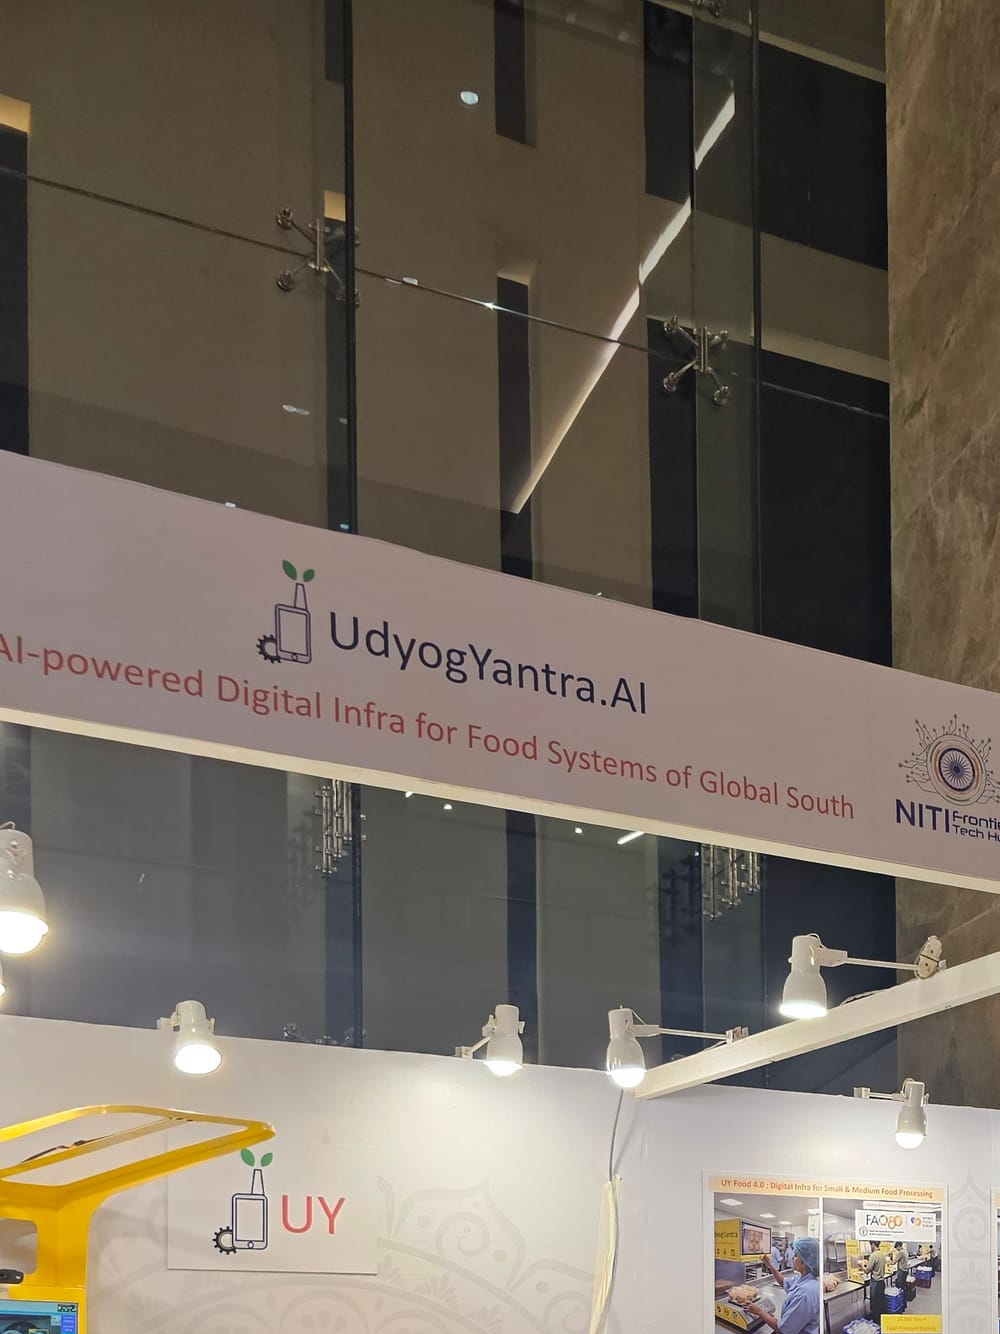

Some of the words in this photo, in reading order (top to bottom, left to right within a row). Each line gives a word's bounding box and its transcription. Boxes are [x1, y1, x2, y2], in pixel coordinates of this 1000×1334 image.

[329, 610, 647, 716] UdyogYantra.AI
[217, 674, 321, 719] Digital
[334, 697, 406, 735] Infra
[415, 711, 457, 744] for
[467, 724, 539, 762] Food
[548, 740, 656, 785] Systems
[665, 765, 692, 790] of
[699, 770, 778, 806] Global
[787, 787, 855, 820] South
[895, 798, 951, 835] NITI
[952, 825, 985, 841] Tech
[734, 1180, 752, 1188] Food
[753, 1181, 765, 1189] 4.0
[770, 1182, 794, 1191] Digital
[795, 1183, 811, 1191] Infra
[812, 1184, 822, 1192] for
[852, 1187, 880, 1195] Medium
[881, 1188, 898, 1196] Food
[899, 1189, 934, 1199] Processing
[280, 1194, 346, 1235] UY
